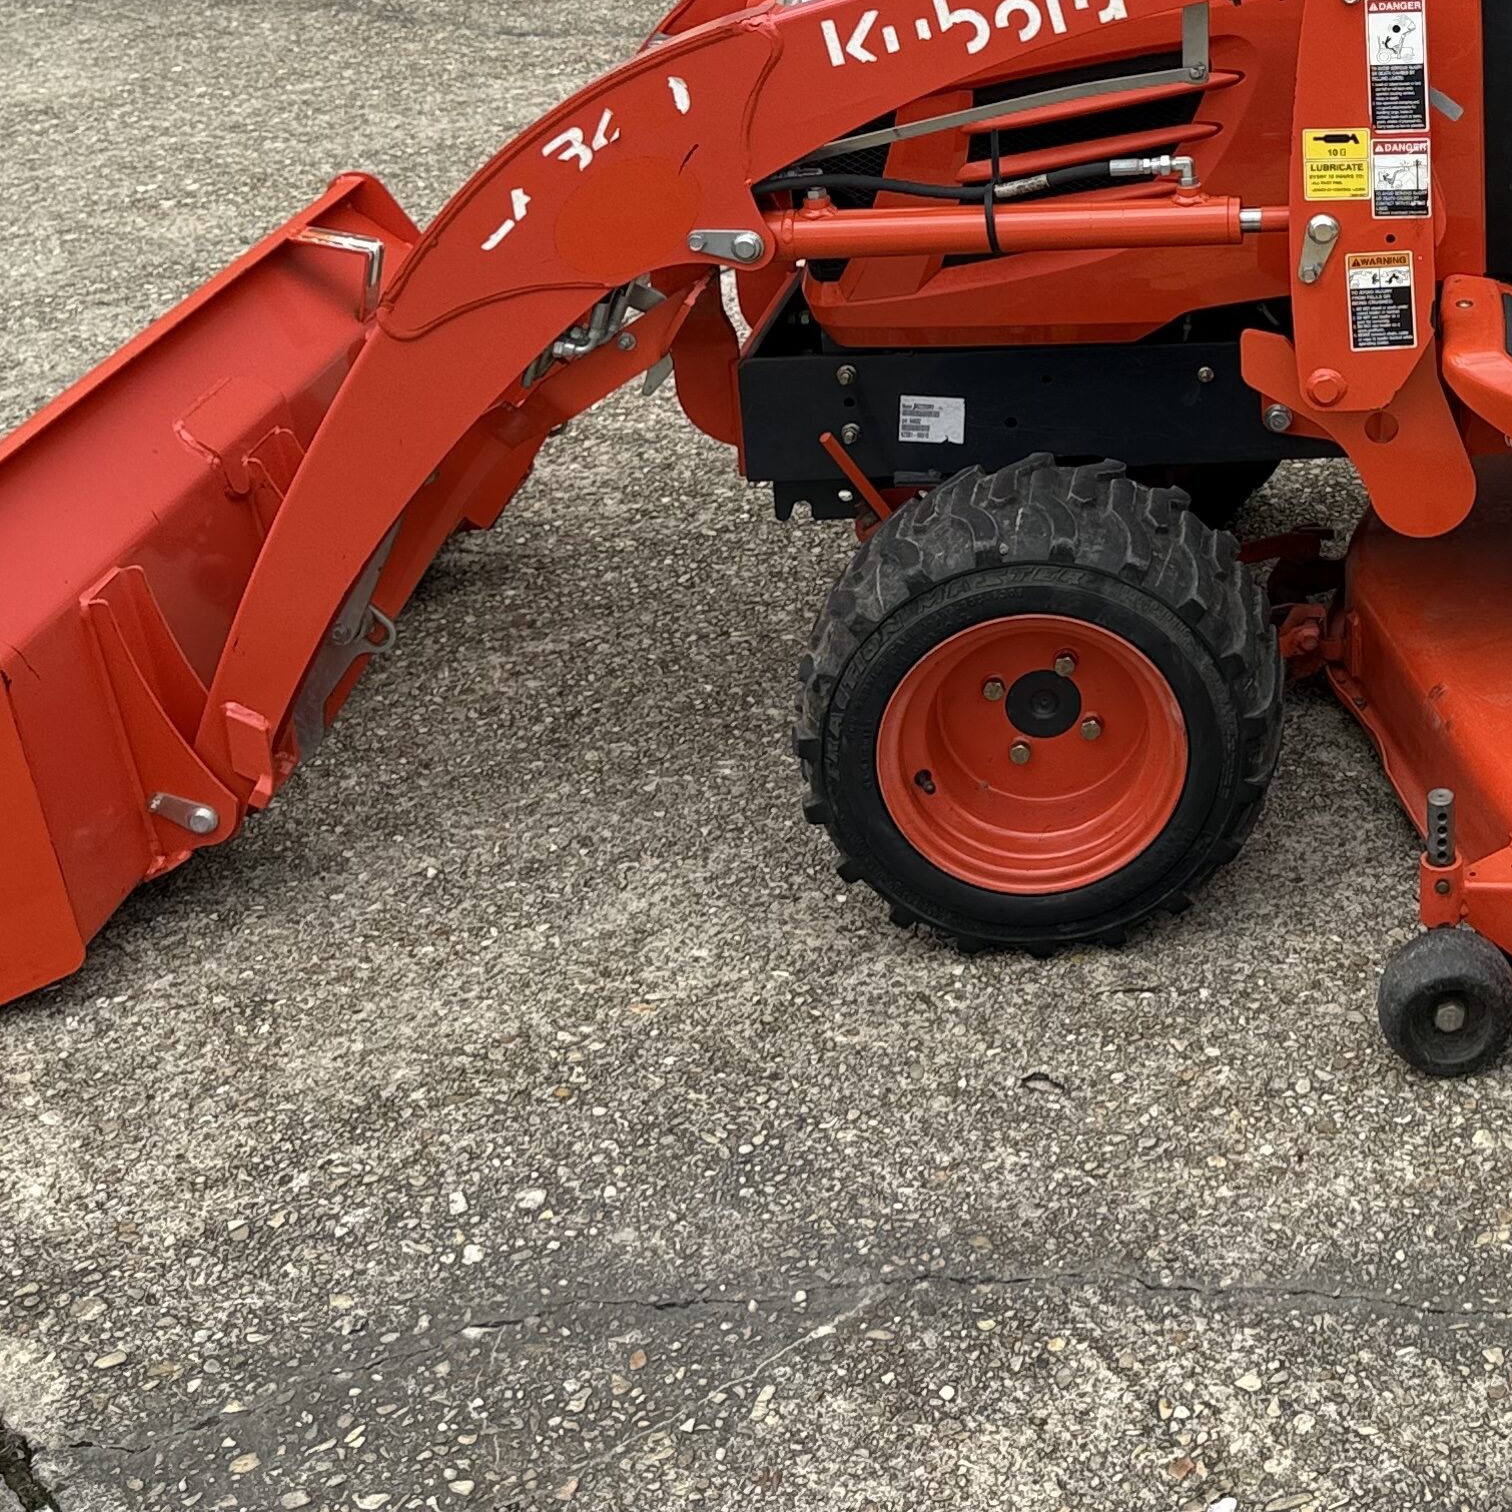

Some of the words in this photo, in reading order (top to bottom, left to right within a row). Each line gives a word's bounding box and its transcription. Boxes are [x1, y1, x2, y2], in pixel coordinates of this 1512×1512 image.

[1379, 1, 1421, 11] DANGER
[1328, 148, 1338, 156] 10
[1384, 142, 1427, 153] DANGER
[1310, 162, 1364, 172] LUBRICATE
[1360, 255, 1407, 266] WARNING
